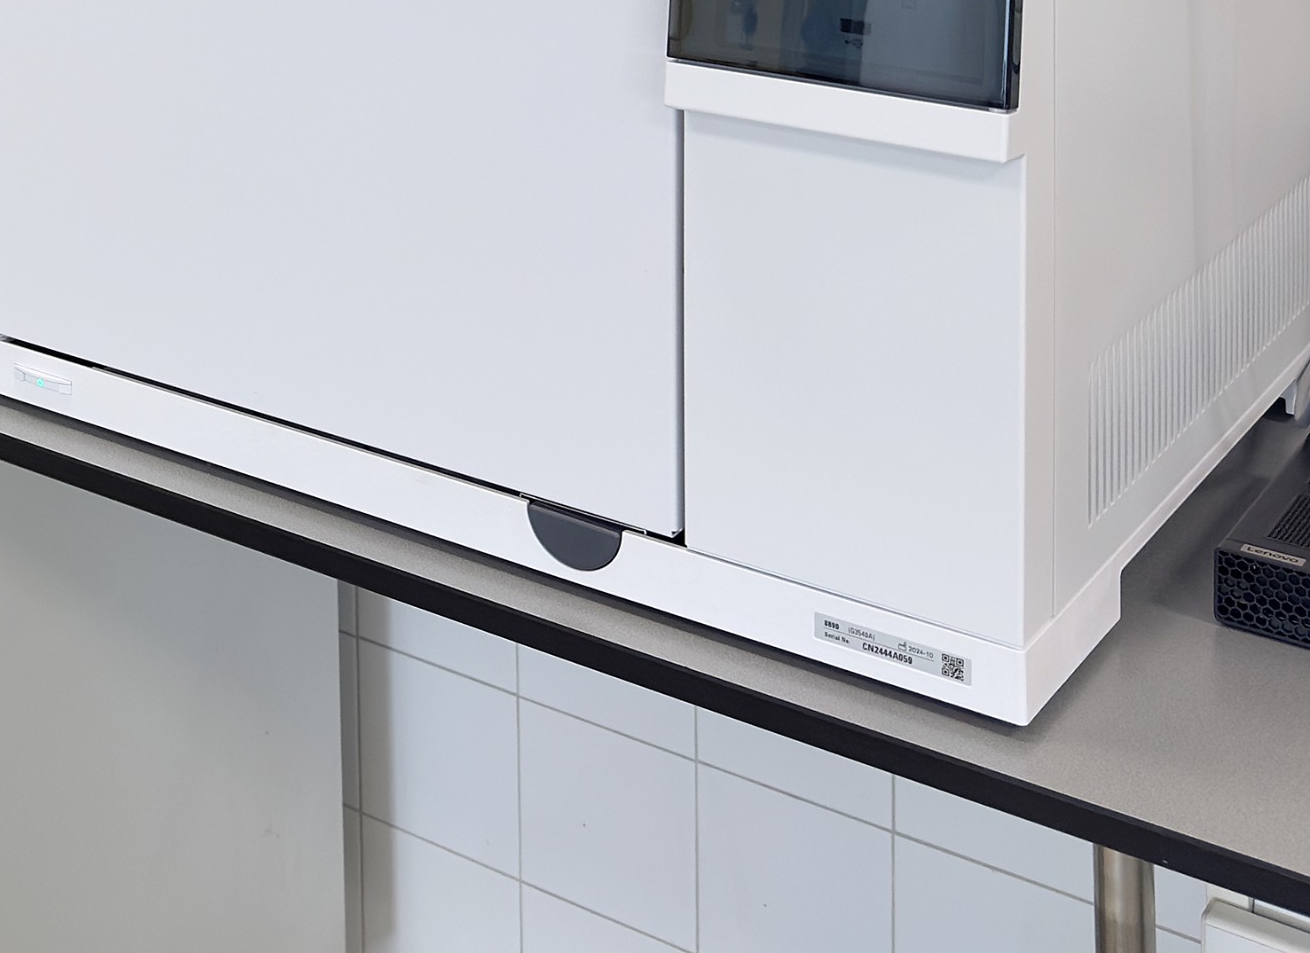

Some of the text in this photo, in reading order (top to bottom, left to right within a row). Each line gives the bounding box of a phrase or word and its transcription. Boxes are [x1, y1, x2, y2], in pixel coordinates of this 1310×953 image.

[1247, 546, 1299, 563] Lenovo
[824, 631, 840, 641] Serial
[862, 642, 913, 665] CN2444A059
